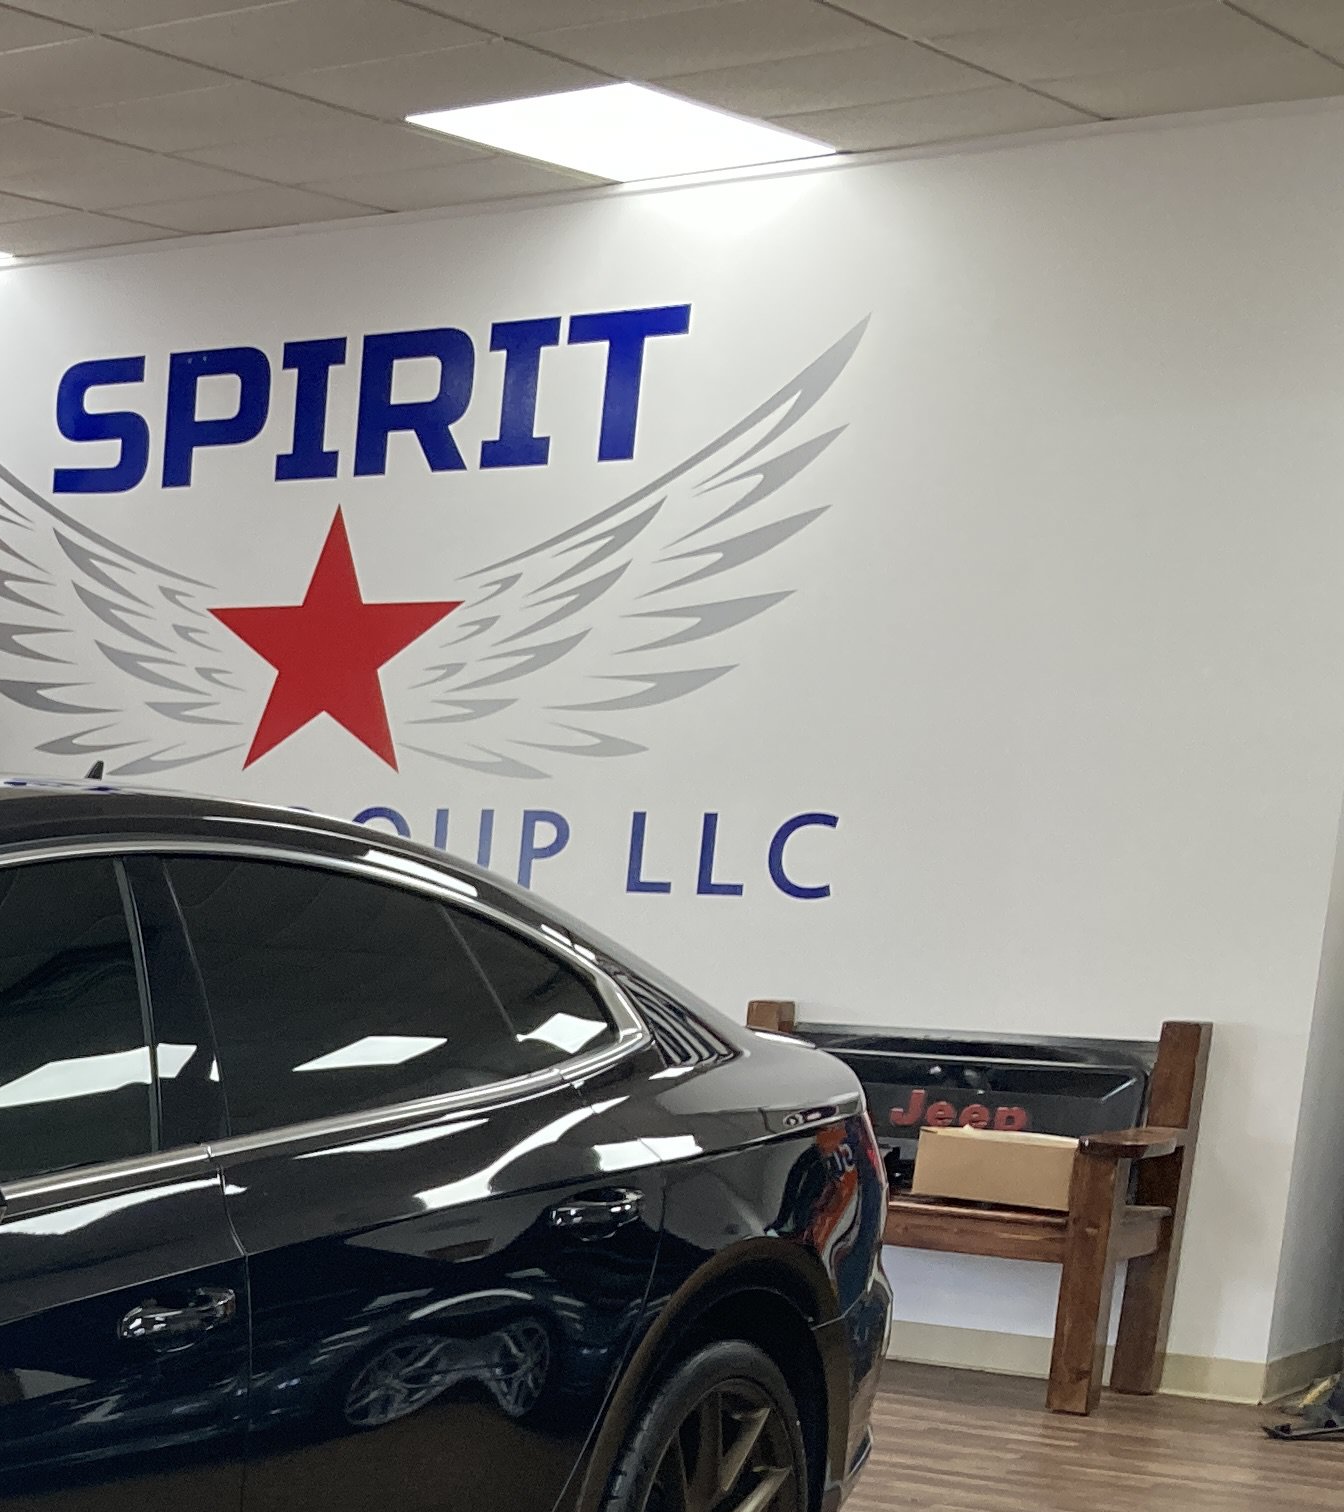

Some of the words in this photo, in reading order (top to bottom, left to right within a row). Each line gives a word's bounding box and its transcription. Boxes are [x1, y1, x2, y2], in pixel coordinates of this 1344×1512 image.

[53, 303, 692, 494] SPIRIT
[626, 809, 840, 901] LLC
[890, 1089, 1028, 1131] Jeep
